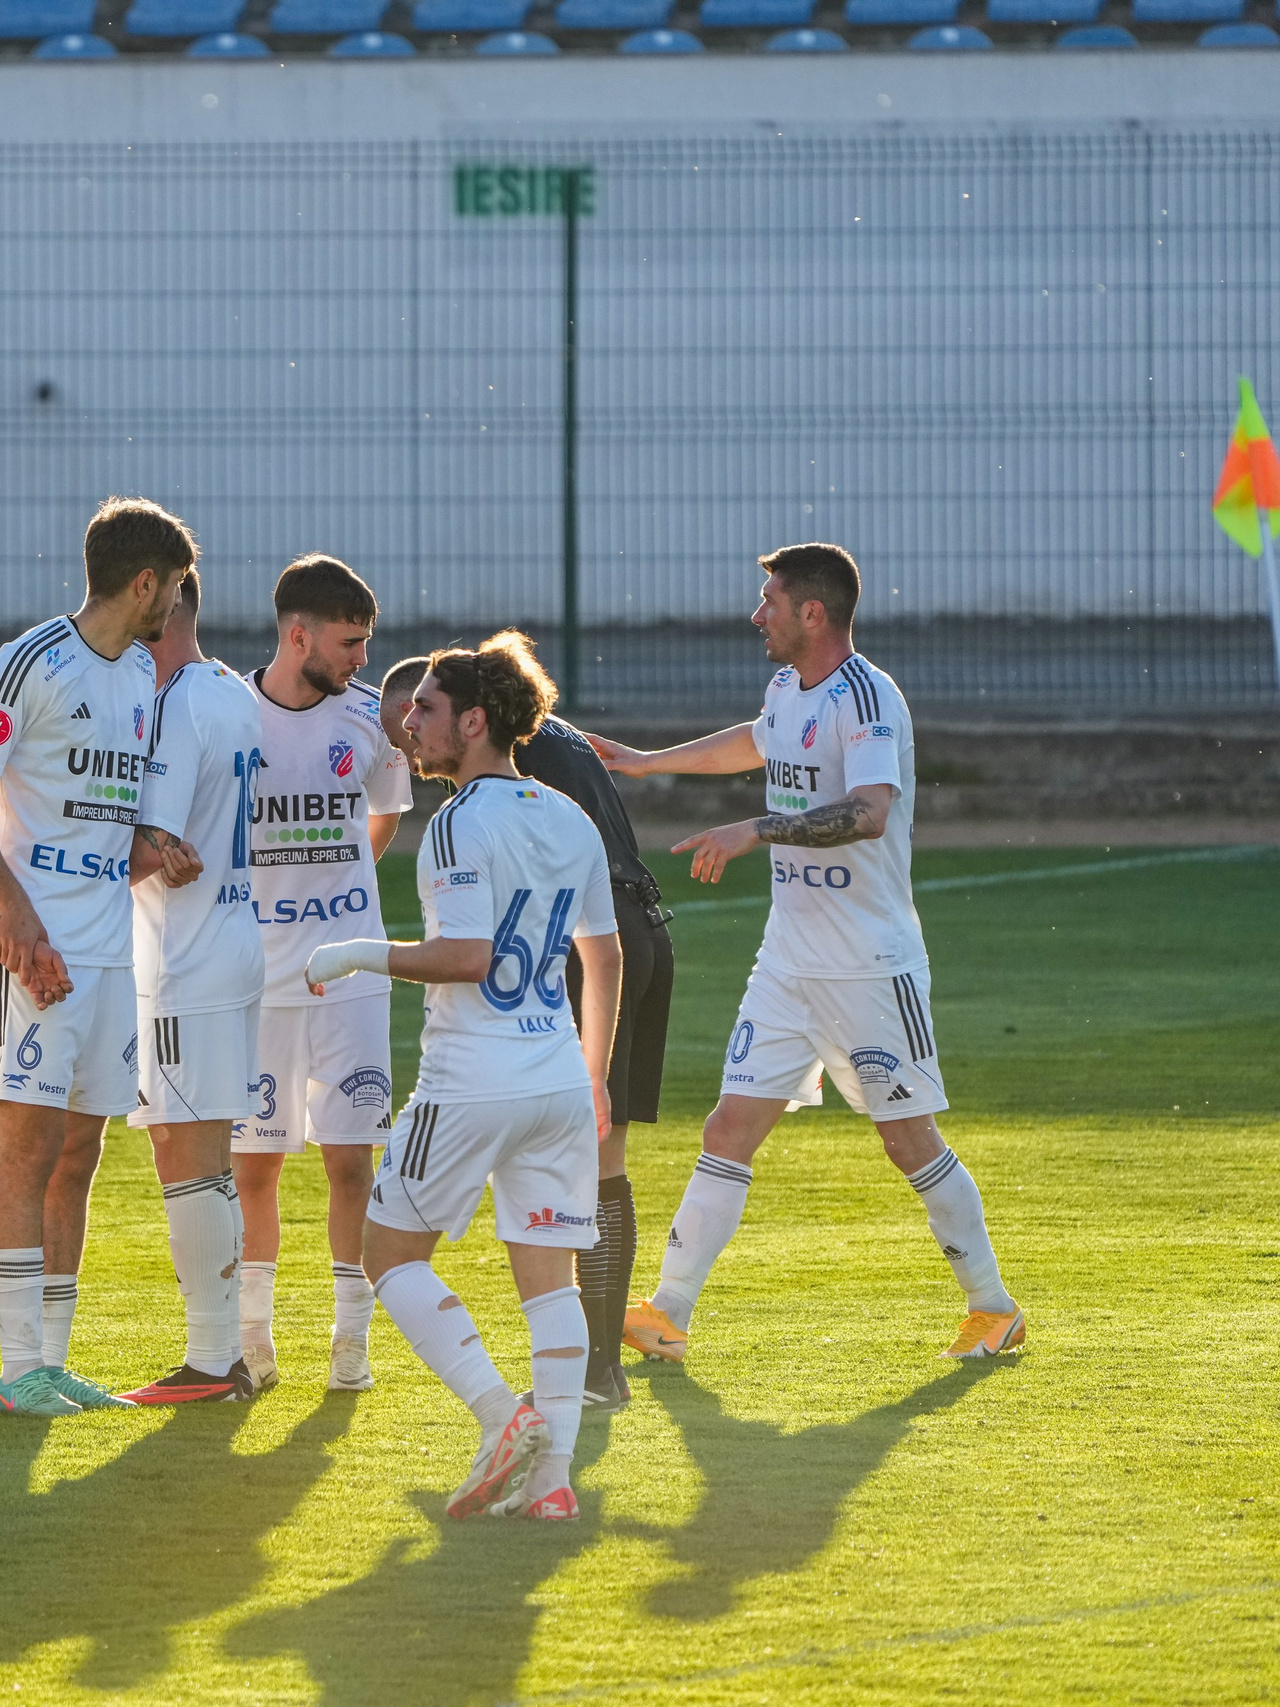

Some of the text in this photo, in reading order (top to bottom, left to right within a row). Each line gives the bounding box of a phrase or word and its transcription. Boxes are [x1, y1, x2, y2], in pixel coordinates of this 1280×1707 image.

[254, 847, 354, 865] ÎMPREUNĂ SPRE 0%
[478, 888, 576, 1012] 66
[17, 1022, 42, 1071] 6
[855, 1053, 897, 1068] CONTINENTS
[38, 1081, 66, 1095] Vestra
[343, 1078, 359, 1092] FIVE
[255, 1127, 287, 1138] Vestra
[554, 1211, 593, 1227] Smart
